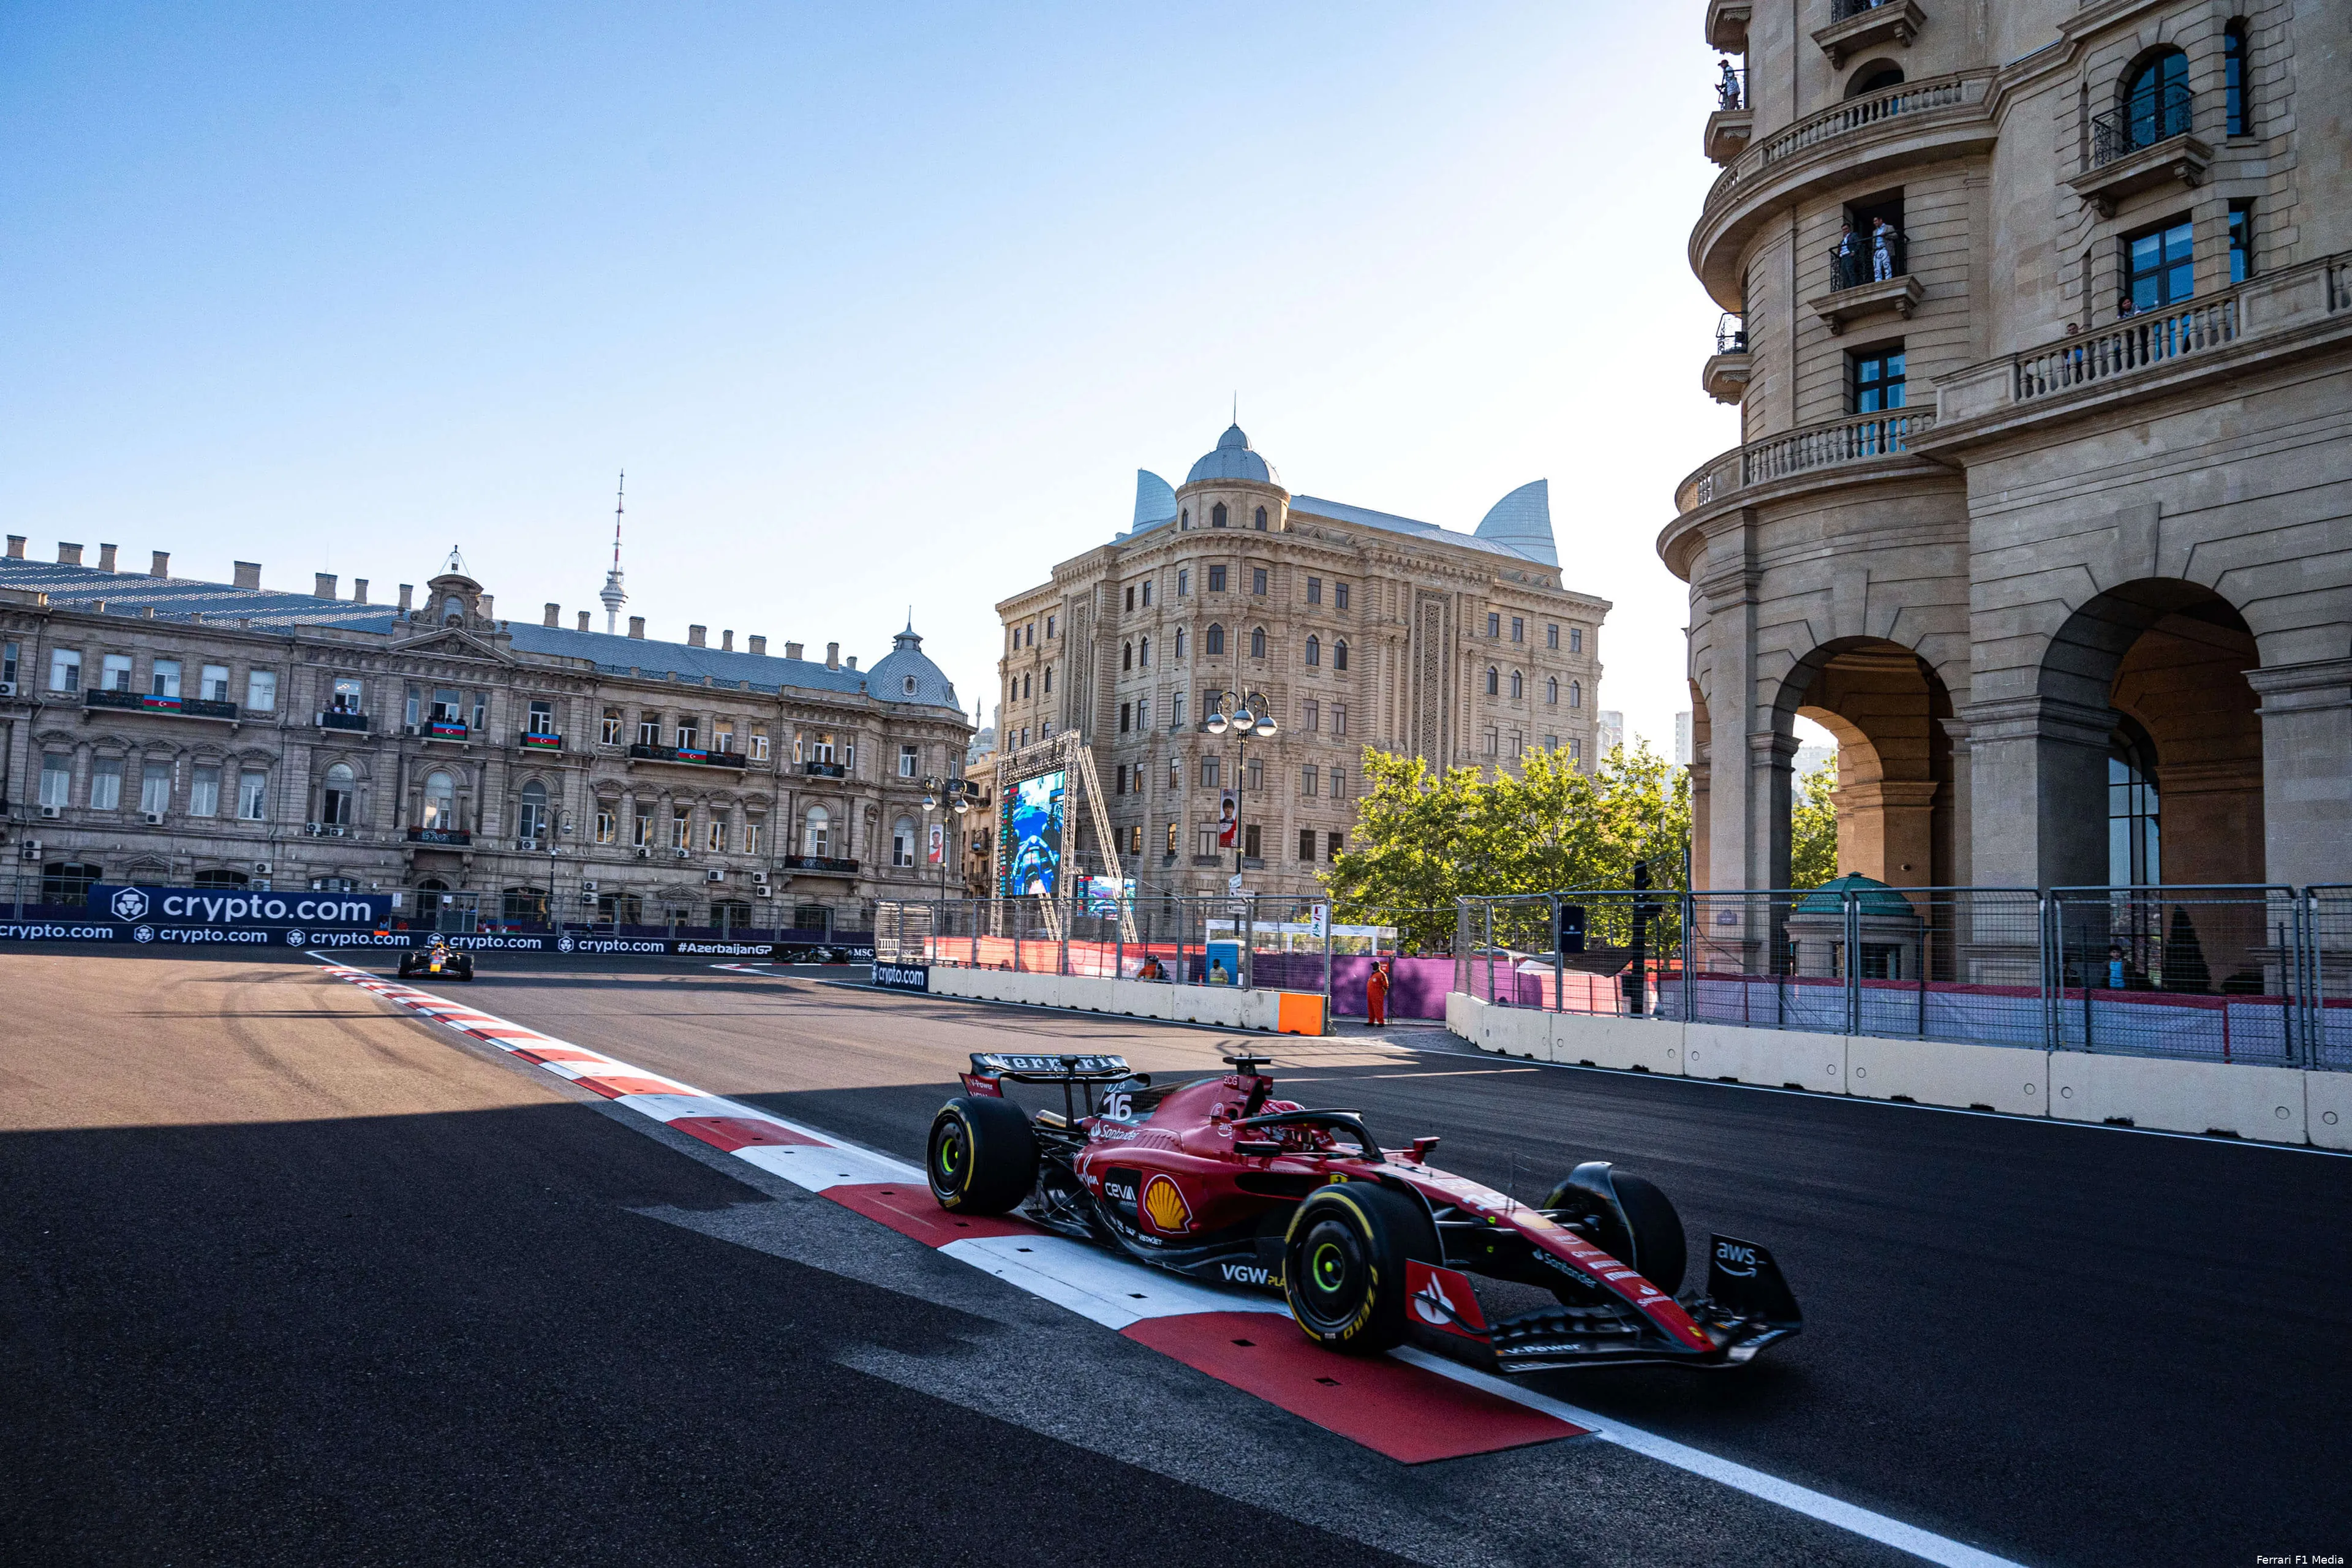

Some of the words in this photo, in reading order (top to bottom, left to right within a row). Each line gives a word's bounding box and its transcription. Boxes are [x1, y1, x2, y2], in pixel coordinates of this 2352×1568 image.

[163, 894, 371, 922] crypto.com
[0, 924, 113, 939] crypto.com
[160, 929, 268, 943] crypto.com
[311, 932, 410, 946] crypto.com
[449, 935, 541, 949] crypto.com
[579, 939, 664, 952] crypto.com
[677, 943, 772, 955] #AzerbaijanGP
[853, 948, 874, 957] MSC
[878, 965, 924, 986] crypto.com
[995, 1054, 1110, 1069] Ferrri
[1101, 1093, 1132, 1121] 16
[1100, 1125, 1139, 1140] Santander
[1717, 1242, 1756, 1265] aws
[1221, 1264, 1268, 1284] VGW
